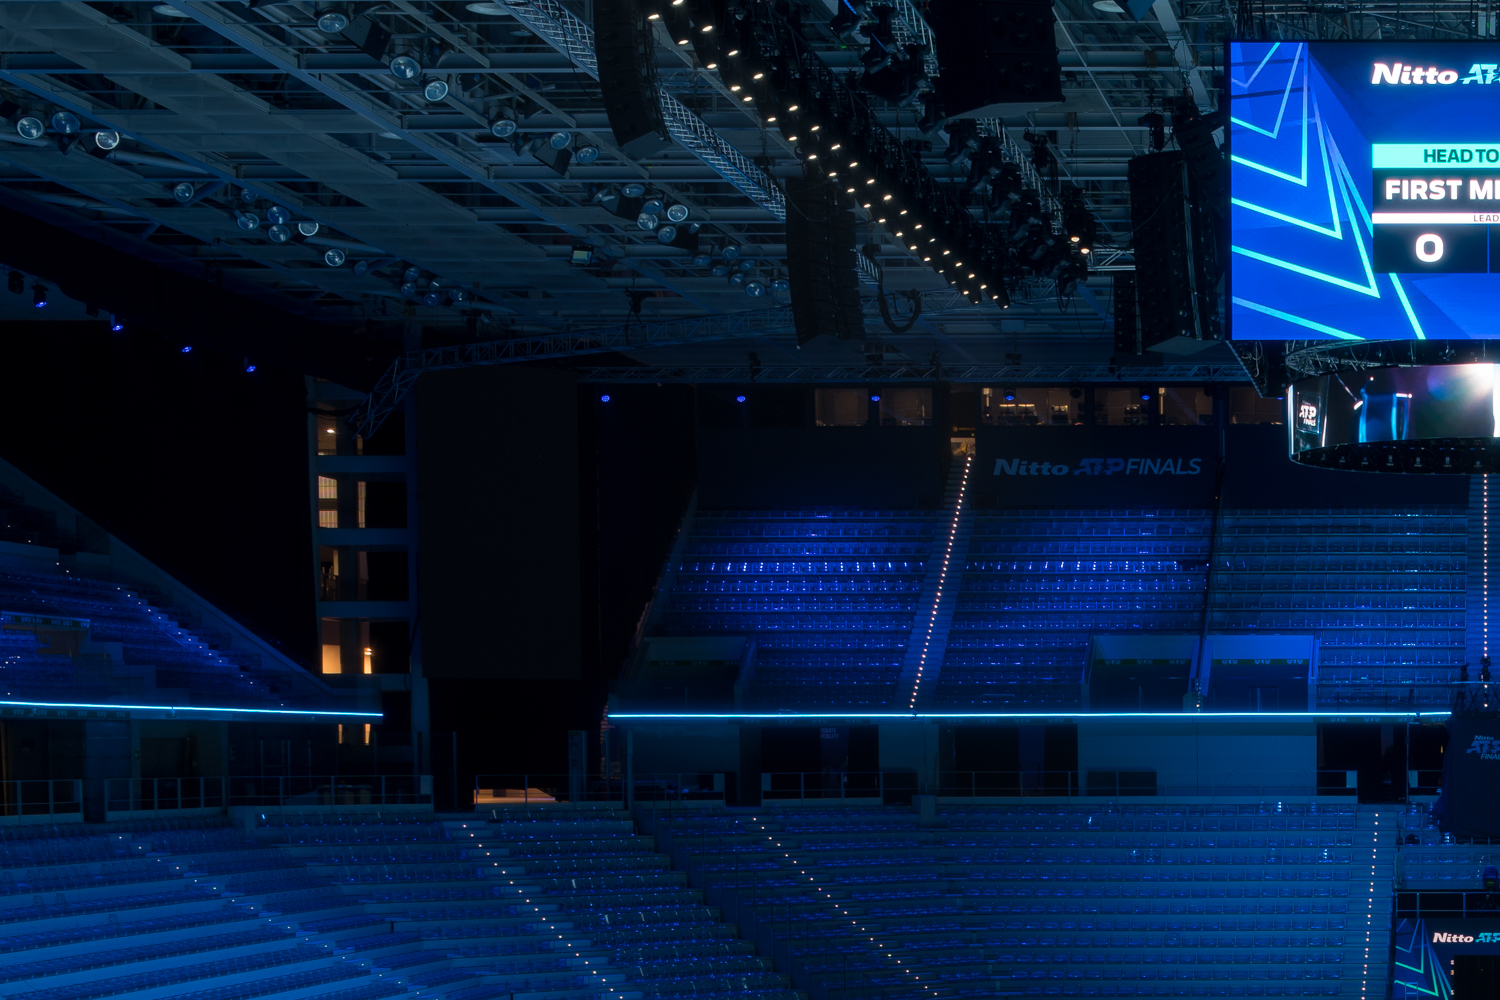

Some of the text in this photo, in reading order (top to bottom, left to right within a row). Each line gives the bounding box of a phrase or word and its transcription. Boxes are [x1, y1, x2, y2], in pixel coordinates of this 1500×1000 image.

[1371, 62, 1458, 85] Nitto
[1423, 148, 1473, 164] HEAD
[1476, 148, 1500, 164] TO
[1385, 179, 1463, 200] FIRST
[993, 458, 1202, 475] Nitto ATP FINALS
[1433, 932, 1474, 943] Nitto
